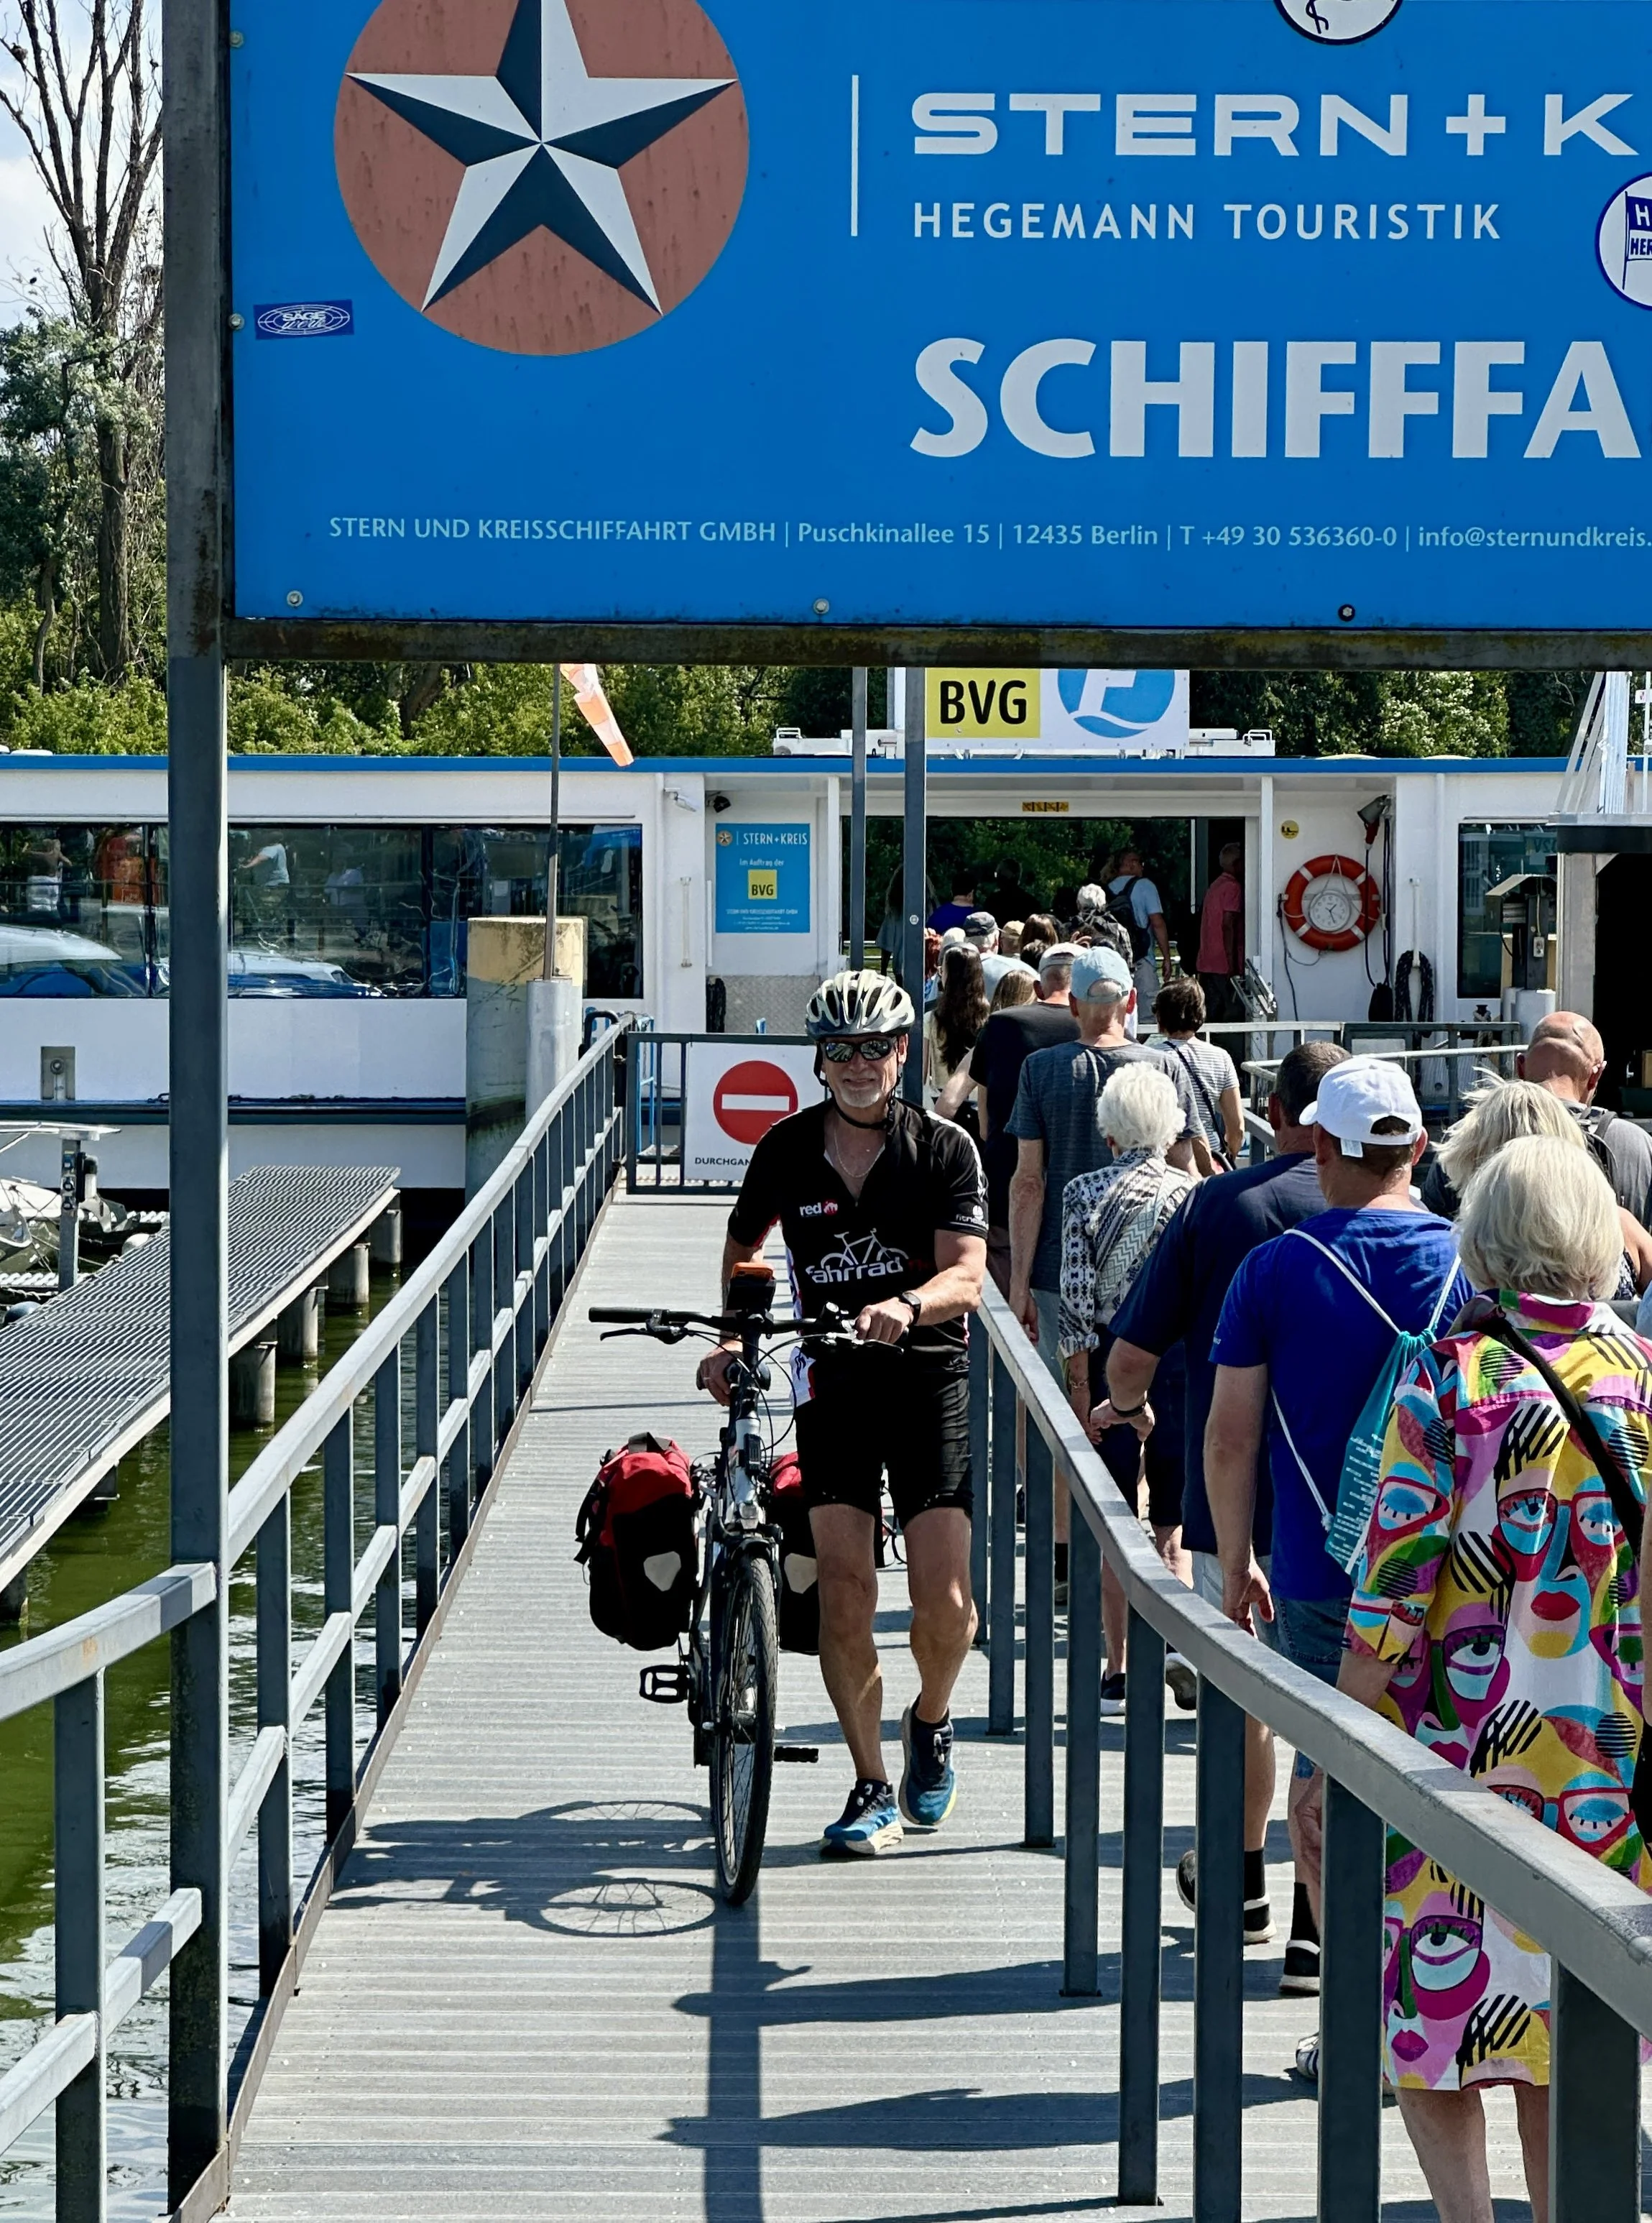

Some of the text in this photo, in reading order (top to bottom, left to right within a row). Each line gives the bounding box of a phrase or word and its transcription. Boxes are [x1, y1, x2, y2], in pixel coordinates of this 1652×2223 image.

[911, 93, 1408, 156] STERN
[914, 202, 1500, 240] HEGEMANN TOURISTIK
[910, 337, 1642, 459] SCHIFFFA
[329, 517, 405, 538] STERN
[415, 519, 470, 538] UND
[479, 520, 692, 540] KREISSCHIFFAHRT
[700, 523, 776, 541] GMBH
[798, 522, 954, 543] Puschkinallee
[964, 525, 990, 543] 15
[1013, 525, 1082, 544] 12435
[1091, 525, 1158, 545] Berlin
[1179, 526, 1195, 544] T
[1202, 527, 1245, 546] +49
[1252, 527, 1280, 546] 30
[1289, 527, 1397, 546] 536360-0
[940, 680, 1028, 724] BVG
[752, 883, 774, 896] BVG
